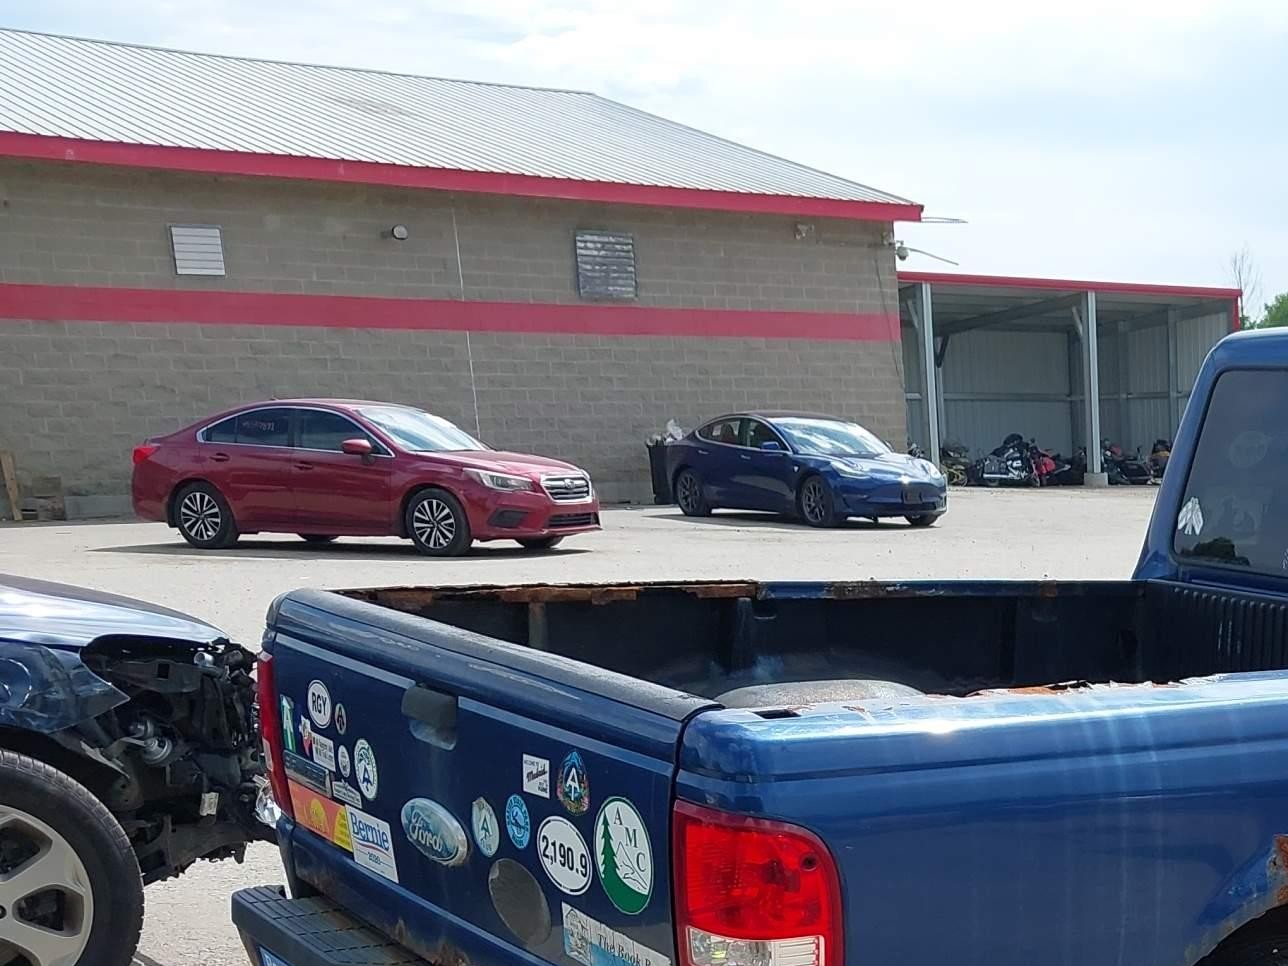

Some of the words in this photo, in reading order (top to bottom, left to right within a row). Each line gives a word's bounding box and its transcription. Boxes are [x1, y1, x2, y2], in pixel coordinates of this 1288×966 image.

[311, 691, 327, 716] RGY
[350, 812, 390, 852] Bernie
[409, 809, 443, 852] Ford
[541, 835, 588, 878] 2,190.9
[598, 934, 616, 957] The
[618, 944, 642, 966] Book
